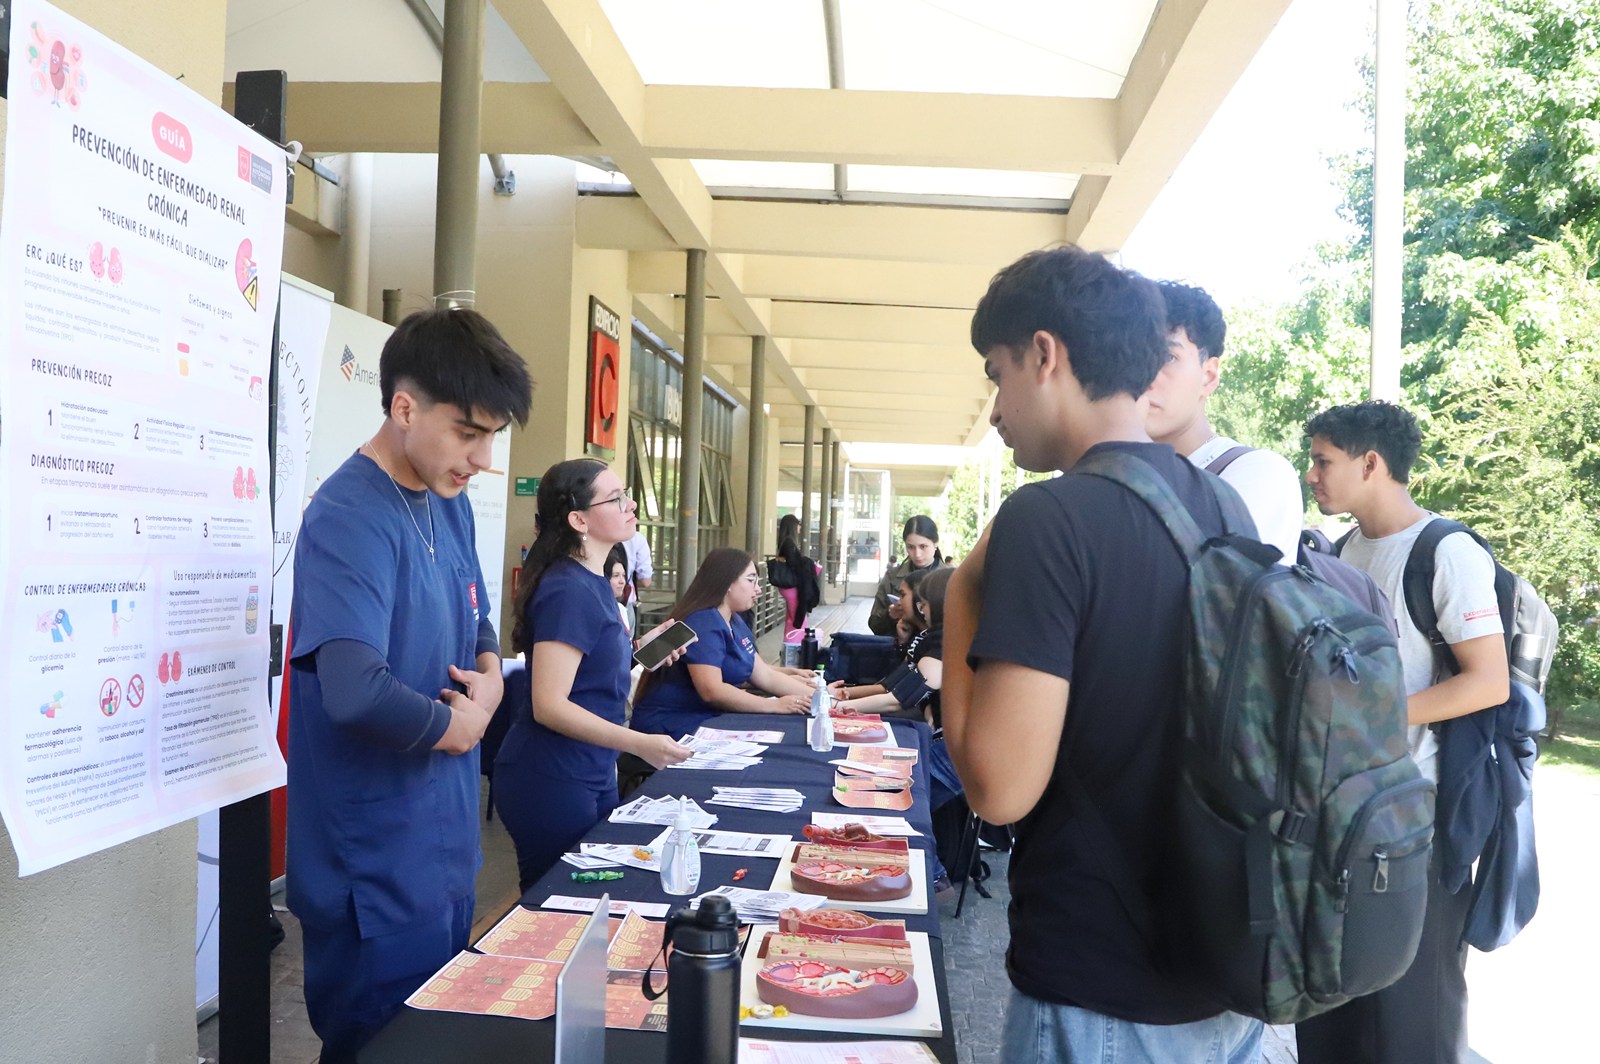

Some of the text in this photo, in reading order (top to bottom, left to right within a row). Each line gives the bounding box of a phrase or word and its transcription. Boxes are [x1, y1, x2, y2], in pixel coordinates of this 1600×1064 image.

[159, 126, 187, 151] GUÍA
[72, 124, 140, 175] PREVENCIÓN
[142, 158, 154, 182] DE
[158, 165, 218, 212] ENFERMEDAD
[221, 196, 246, 225] RENAL
[148, 193, 188, 228] CRÓNICA
[139, 223, 147, 238] ES
[150, 228, 164, 245] MÁS
[166, 235, 184, 253] FÁCIL
[185, 242, 197, 258] QUE
[26, 244, 83, 274] ERC ¿QUÉ ES?
[594, 304, 620, 340] EDIFICIO
[32, 358, 112, 387] PREVENCIÓN PRECOZ
[600, 352, 616, 432] C
[48, 408, 52, 426] 1
[134, 422, 140, 440] 2
[199, 434, 205, 450] 3
[31, 454, 115, 476] DIAGNÓSTICO PRECOZ
[46, 514, 52, 532] 1
[134, 516, 141, 534] 2
[203, 522, 209, 539] 3
[173, 569, 257, 582] Uso responsable de medicamentos
[24, 581, 146, 596] CONTROL DE ENFERMEDADES CRÓNICAS
[40, 663, 64, 674] glicemia
[188, 664, 211, 677] EXÁMENES
[218, 661, 236, 672] CONTROL
[52, 724, 82, 736] adherencia
[24, 738, 64, 752] farmacológica
[26, 771, 51, 783] Controles
[58, 766, 72, 776] salud
